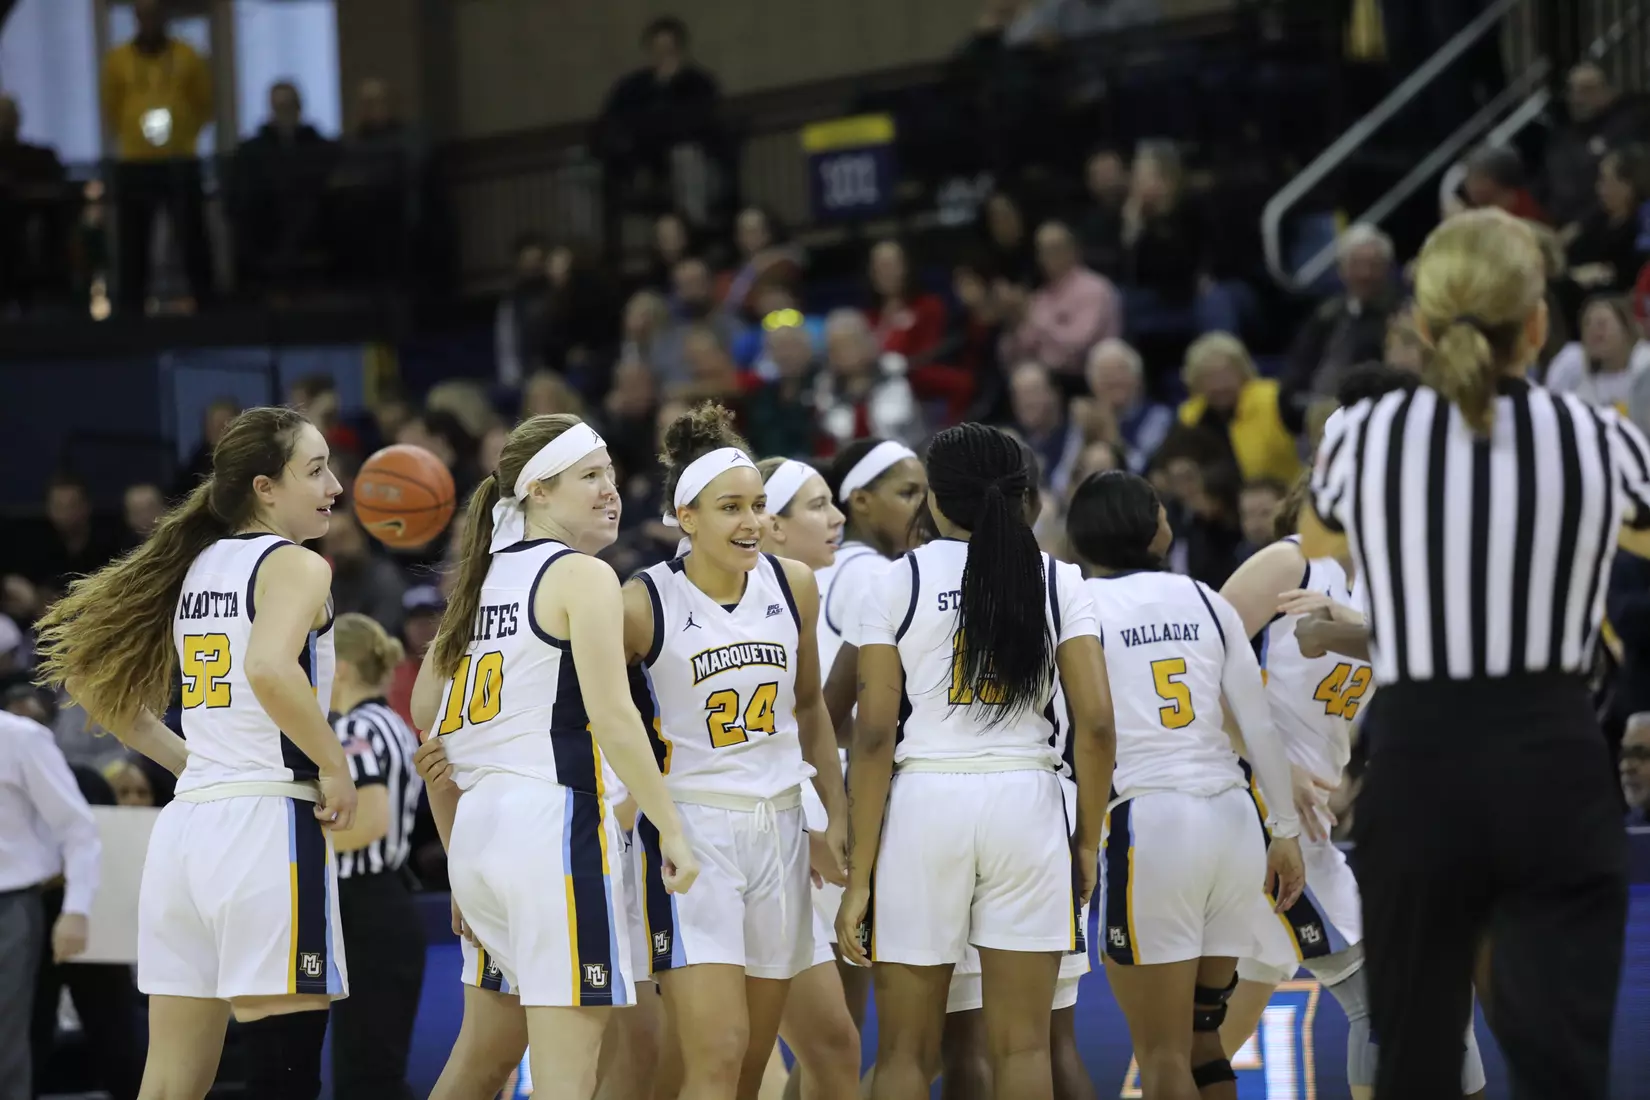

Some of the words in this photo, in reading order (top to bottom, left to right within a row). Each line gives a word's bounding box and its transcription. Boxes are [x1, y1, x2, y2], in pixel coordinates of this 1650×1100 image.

[470, 602, 519, 641] IFES
[1120, 622, 1200, 648] VALLADAY
[182, 632, 232, 710] 52
[690, 641, 788, 687] MARQUETTE
[948, 627, 1009, 705] 1
[437, 650, 504, 736] 10
[1149, 656, 1196, 730] 5
[1312, 662, 1373, 721] 42
[704, 681, 779, 749] 24
[653, 931, 669, 954] MU
[1108, 927, 1125, 948] MU
[1299, 924, 1321, 944] MU
[301, 953, 323, 977] MU
[584, 964, 608, 988] MU
